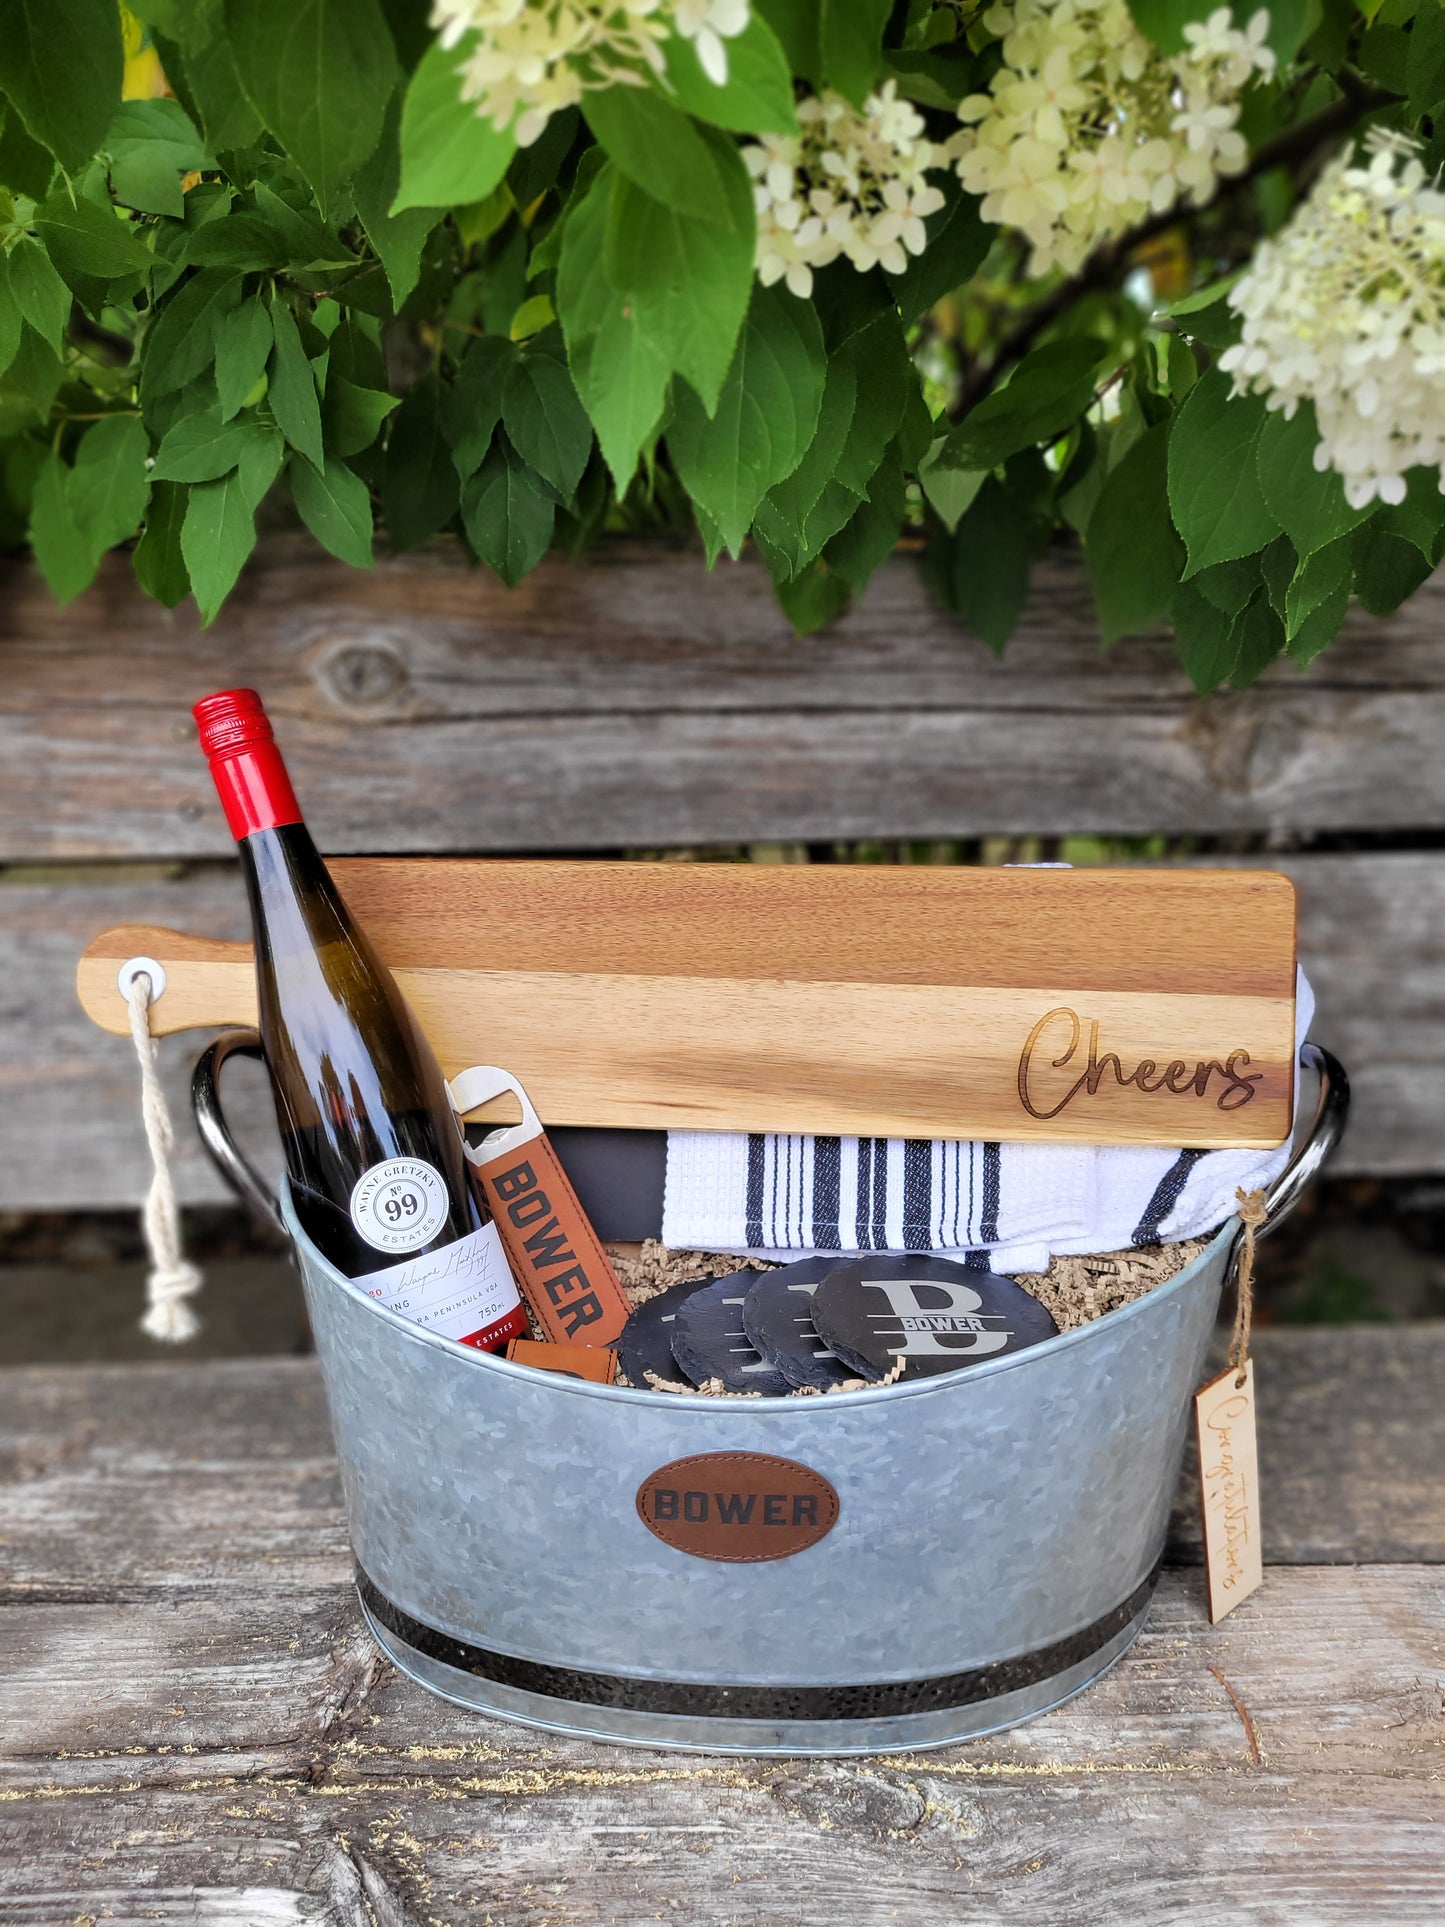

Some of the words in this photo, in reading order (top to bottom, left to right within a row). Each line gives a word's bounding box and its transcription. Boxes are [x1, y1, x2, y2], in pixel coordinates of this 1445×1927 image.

[1018, 1007, 1263, 1120] Cheers
[359, 1175, 382, 1213] WAYNE
[384, 1165, 436, 1188] GRETZKY
[384, 1193, 418, 1222] 99
[382, 1217, 436, 1244] ESTATES
[491, 1160, 604, 1340] BOWER
[434, 1292, 484, 1318] PENINSULA
[476, 1322, 513, 1347] ESTATES
[900, 1317, 987, 1331] BOWER
[654, 1488, 819, 1526] BOWER
